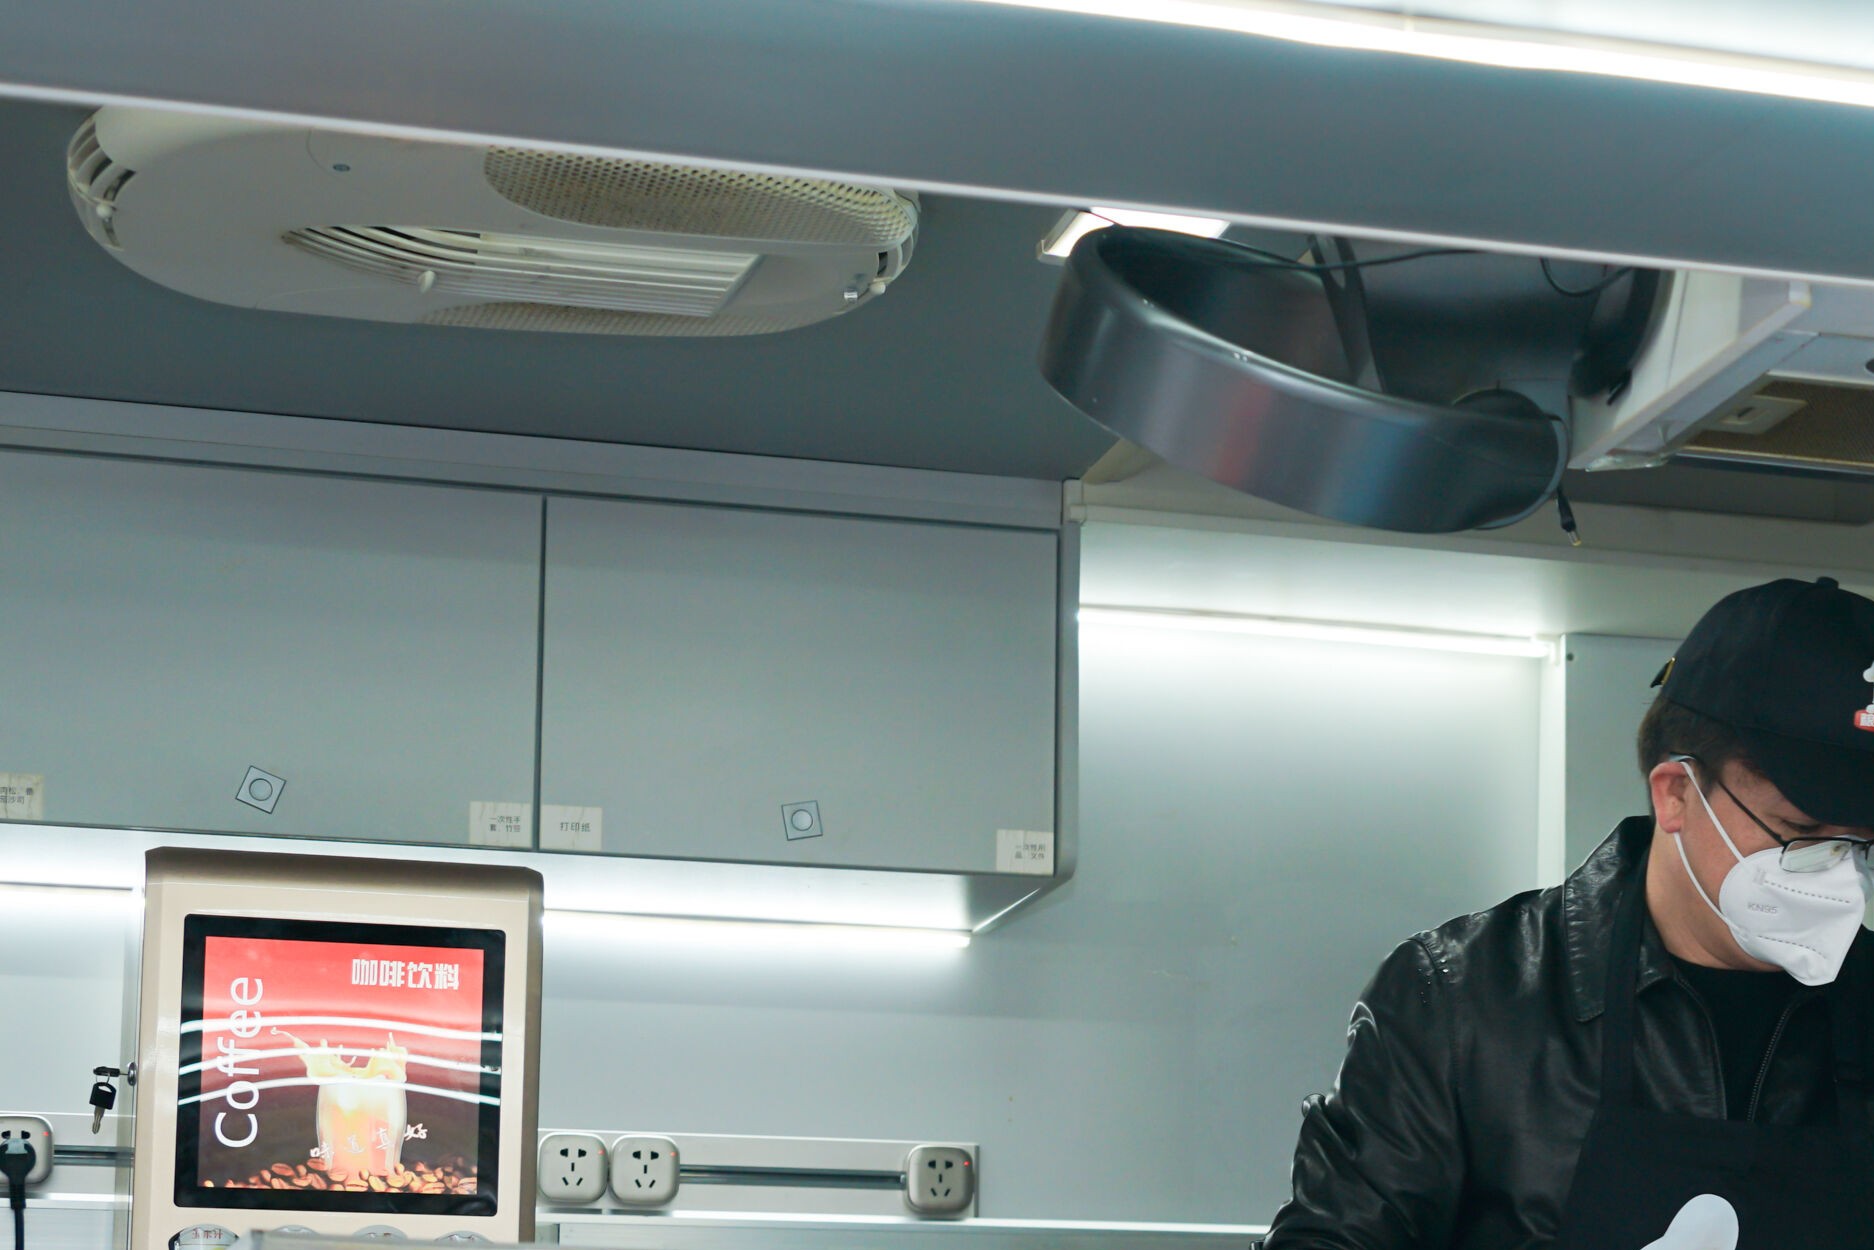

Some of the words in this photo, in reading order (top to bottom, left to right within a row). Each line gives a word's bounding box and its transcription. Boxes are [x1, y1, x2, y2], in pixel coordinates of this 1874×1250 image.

[560, 822, 591, 833] 打印纸
[351, 958, 460, 991] 咖啡饮料
[214, 976, 264, 1148] Coffee
